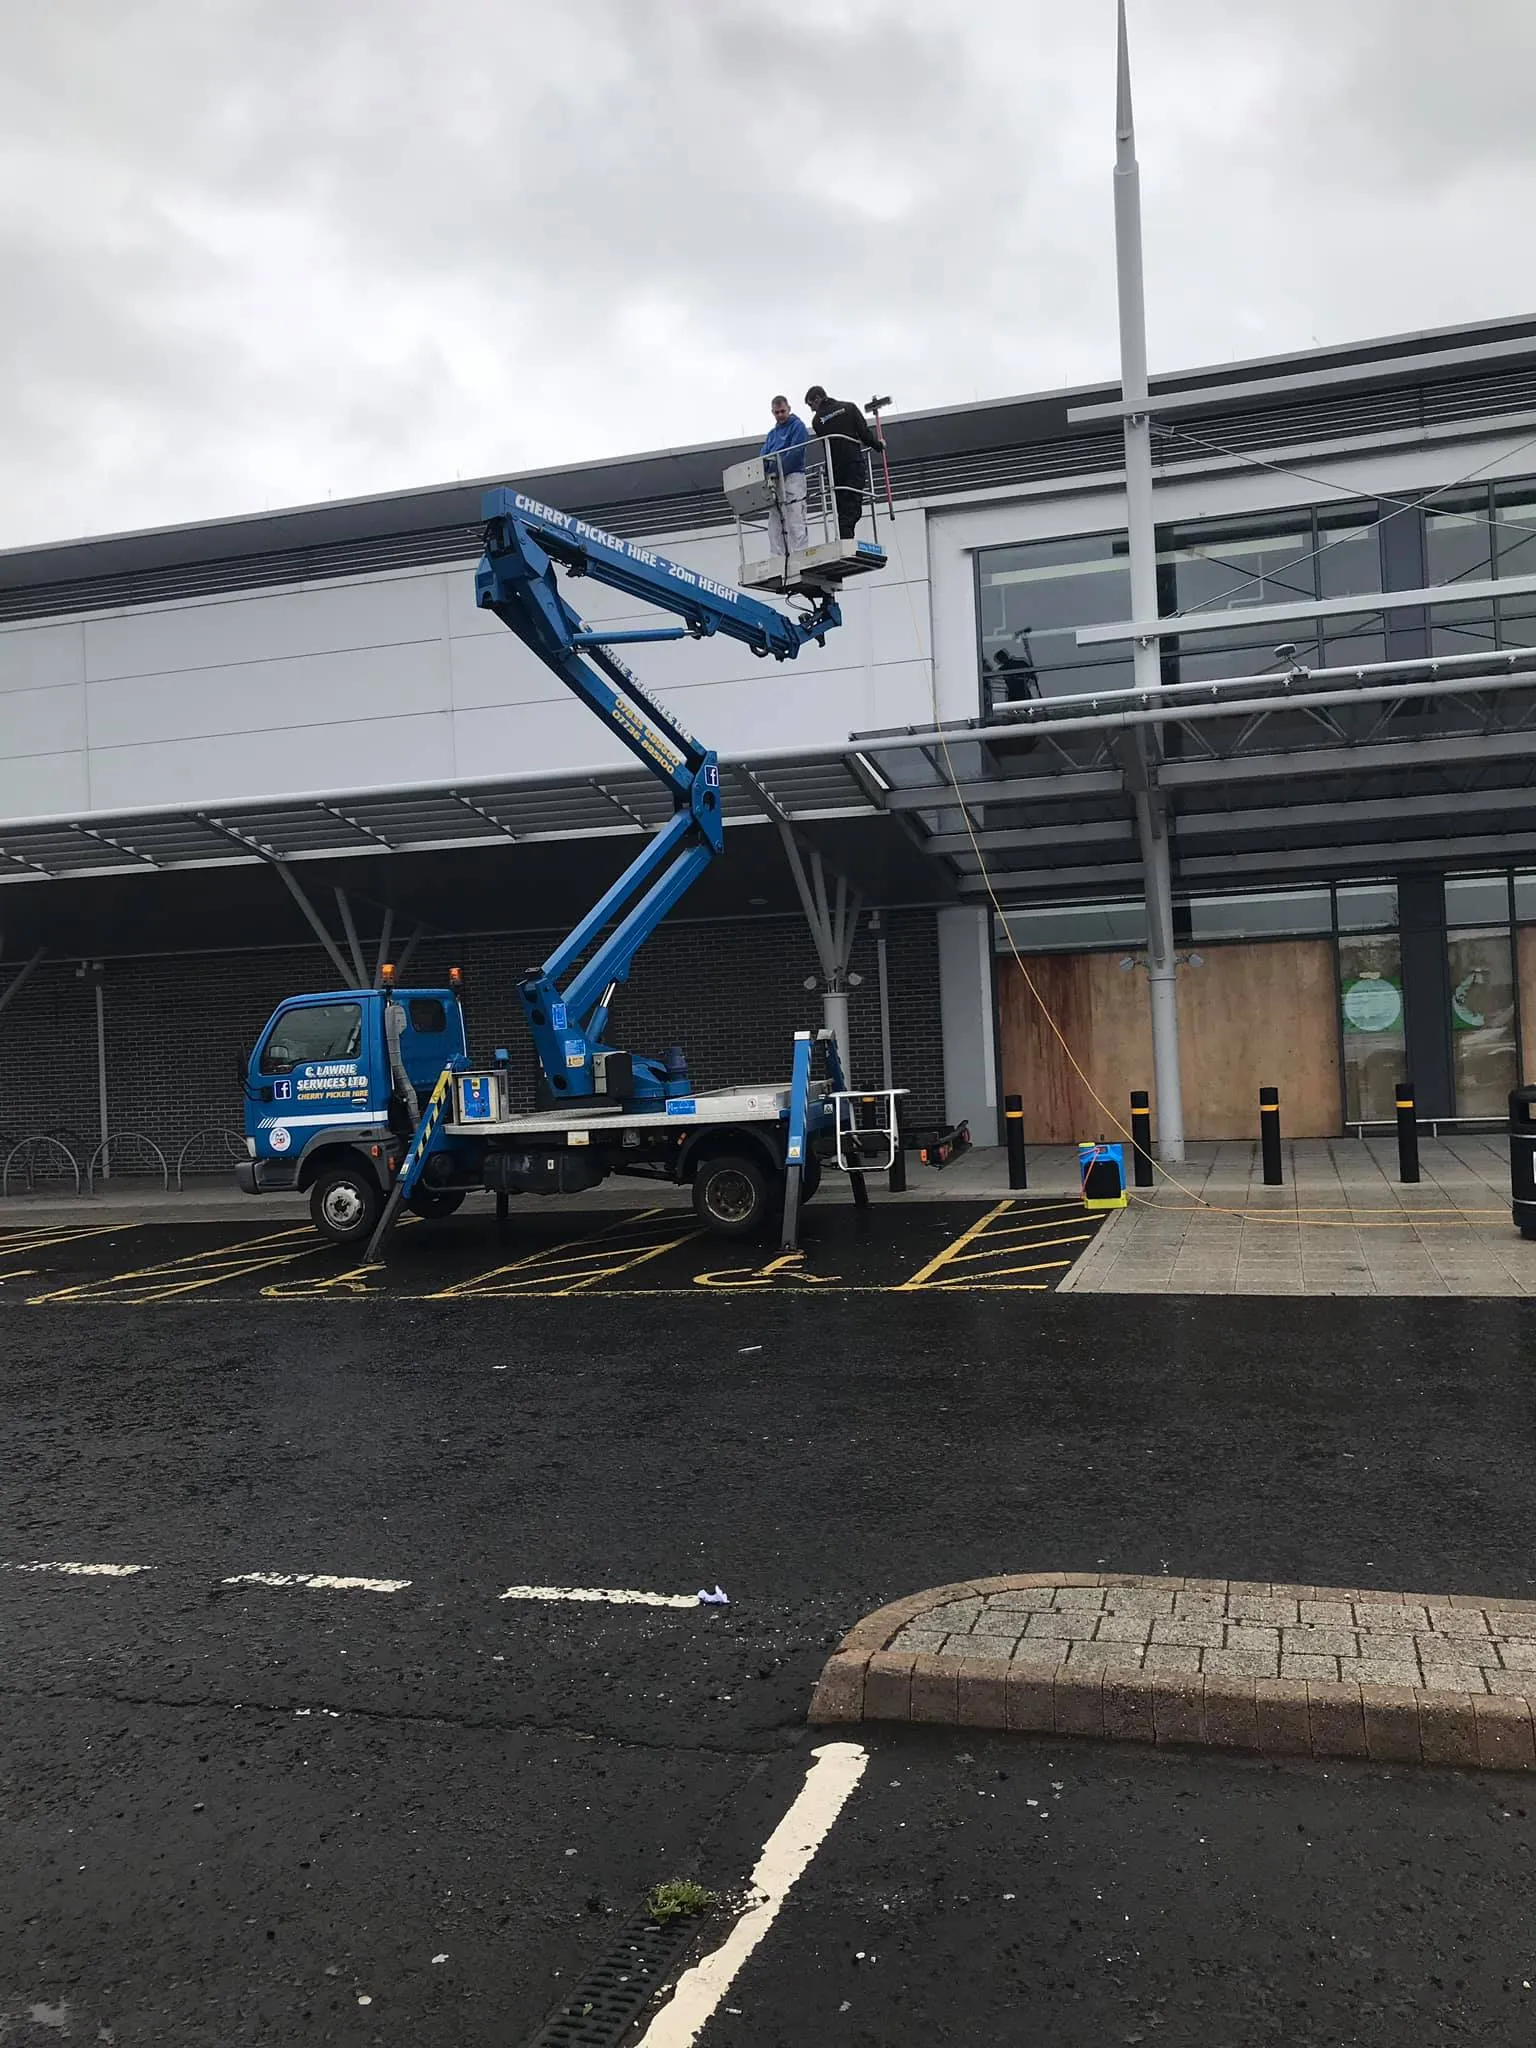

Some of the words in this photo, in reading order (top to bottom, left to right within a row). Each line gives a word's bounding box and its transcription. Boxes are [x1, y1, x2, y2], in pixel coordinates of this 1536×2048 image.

[515, 493, 572, 529] CHERRY
[576, 520, 625, 553] PICKER
[628, 543, 657, 567] HIRE
[668, 562, 696, 585] 20m
[698, 575, 739, 604] HEIGHT
[317, 1064, 358, 1077] LAWRIE
[297, 1078, 347, 1090] SERVICES
[348, 1076, 368, 1088] LTD
[325, 1091, 351, 1099] PICKER
[352, 1089, 368, 1097] HIRE
